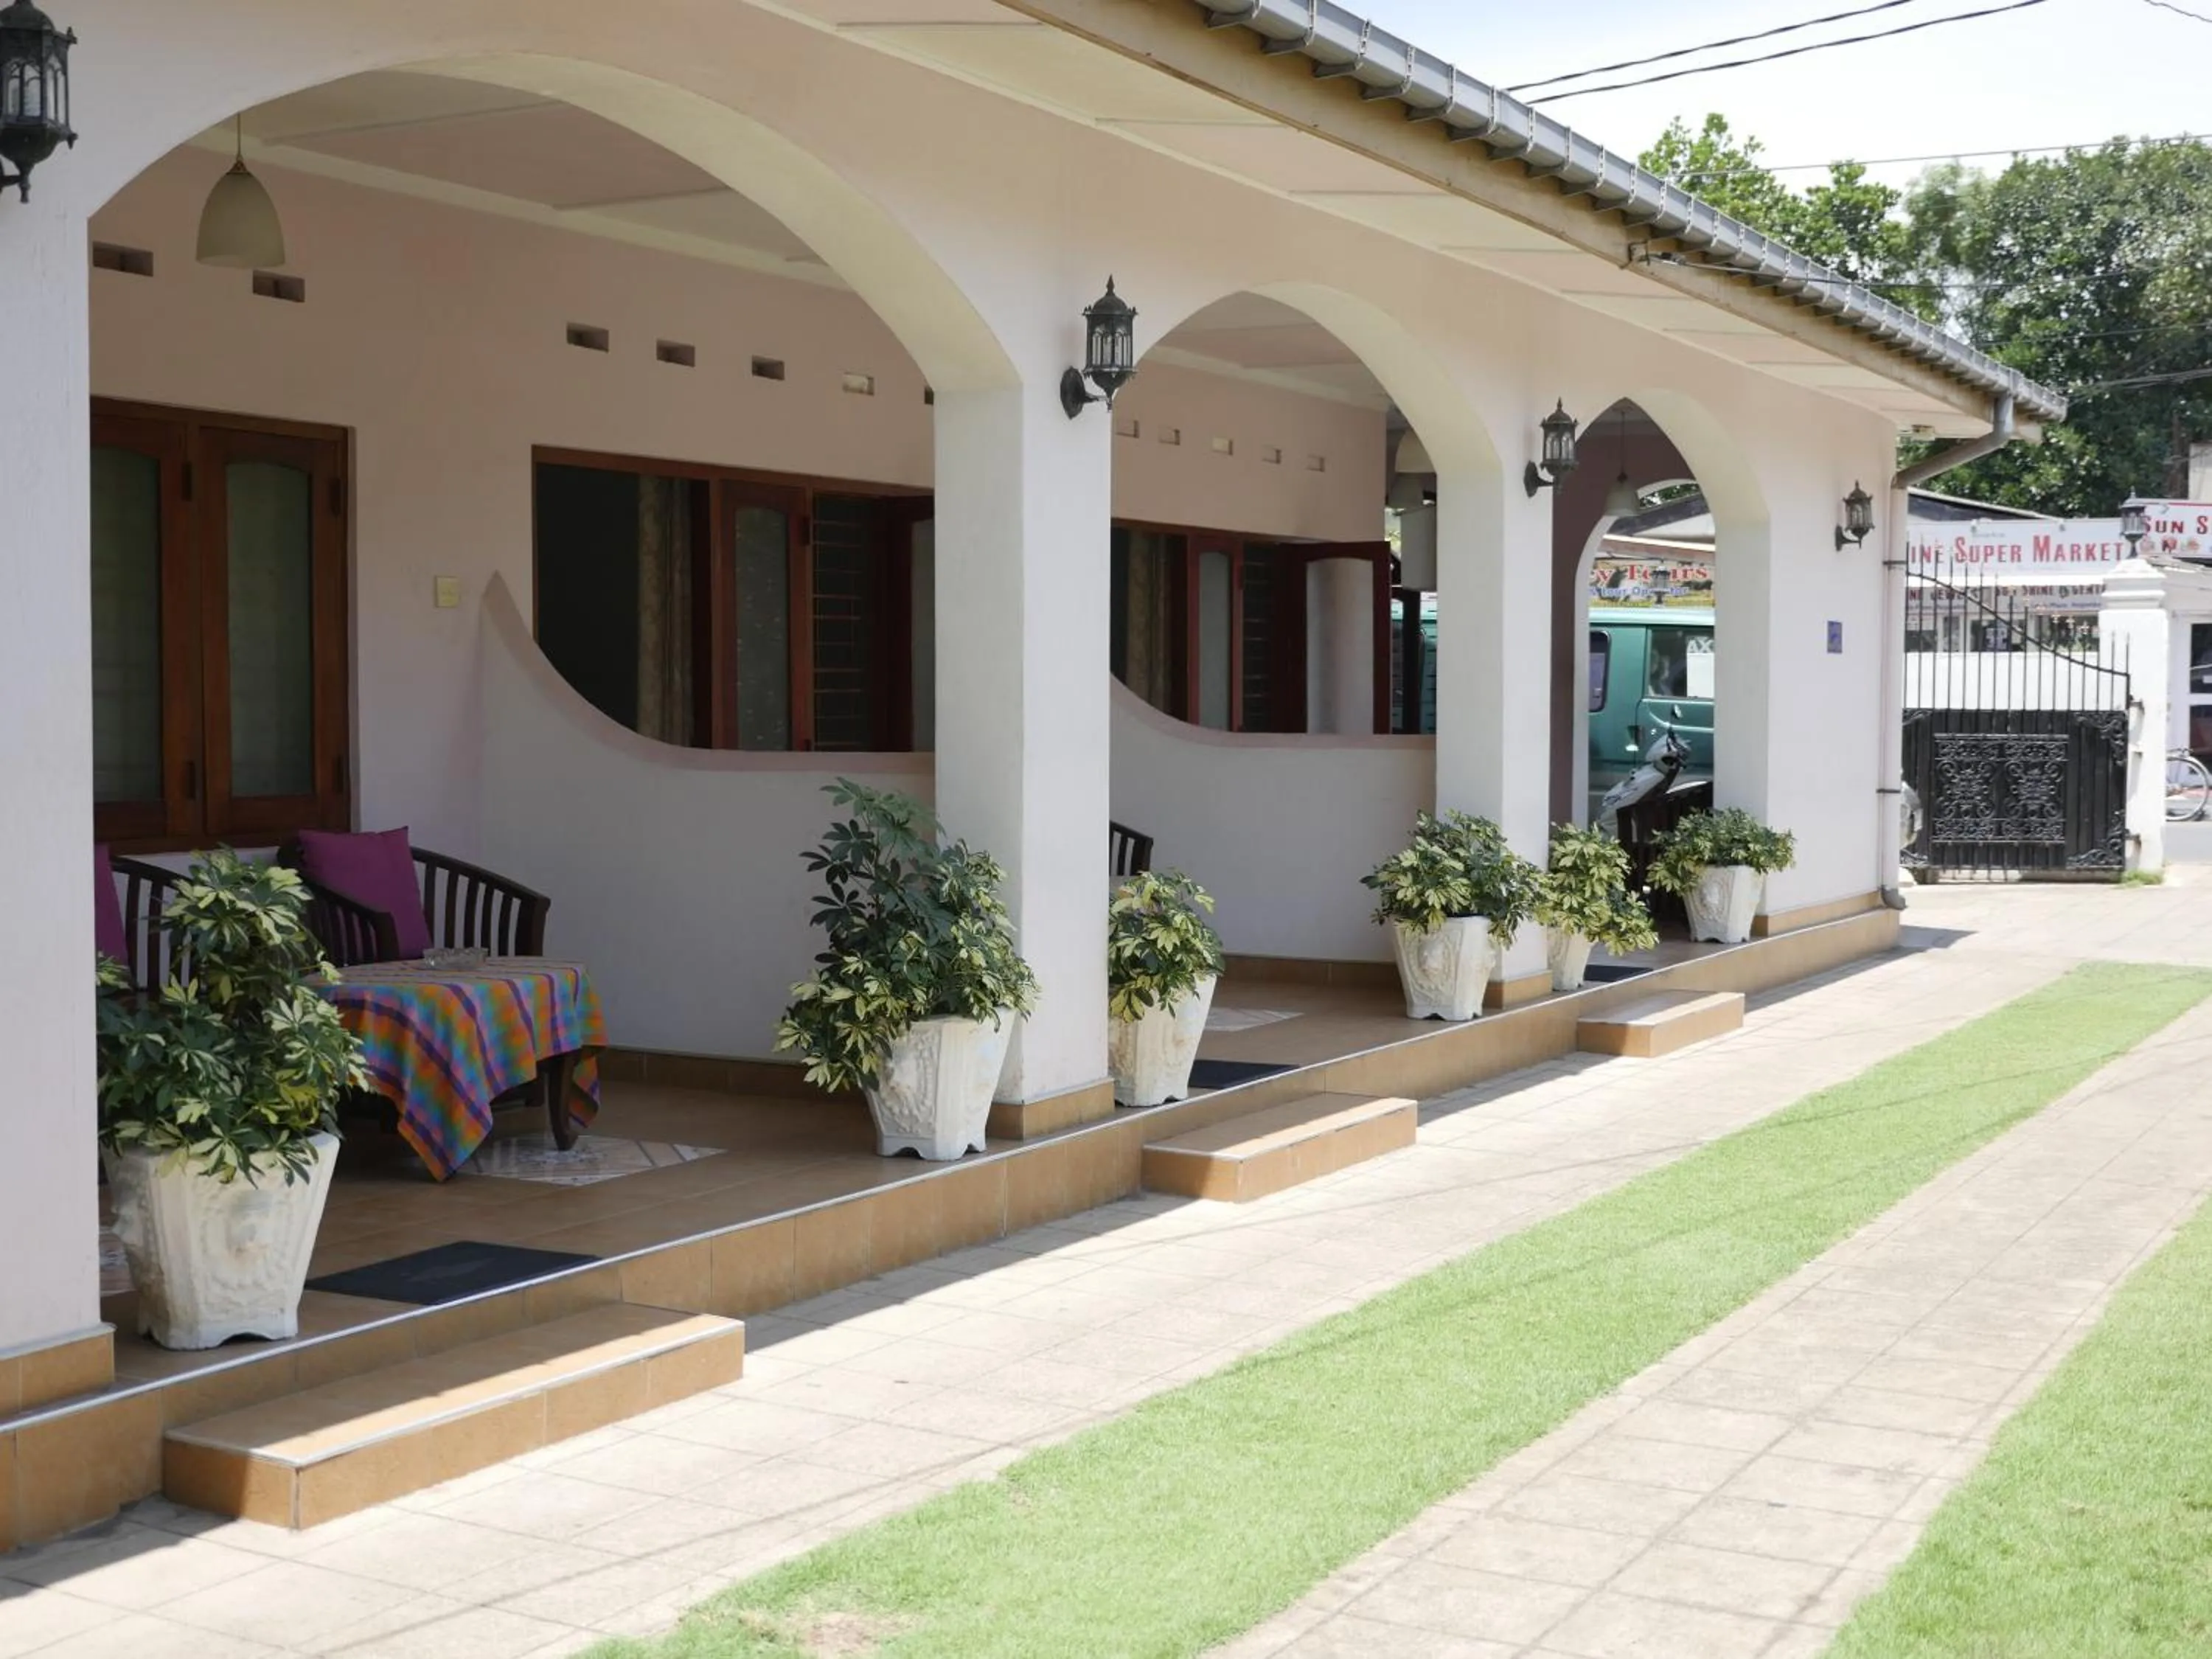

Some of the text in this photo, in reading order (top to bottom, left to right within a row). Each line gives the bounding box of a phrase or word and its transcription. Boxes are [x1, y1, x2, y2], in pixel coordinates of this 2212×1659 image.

[2142, 515, 2183, 535] SUN
[1955, 535, 2022, 563] SUPER
[2033, 534, 2124, 563] MARKET
